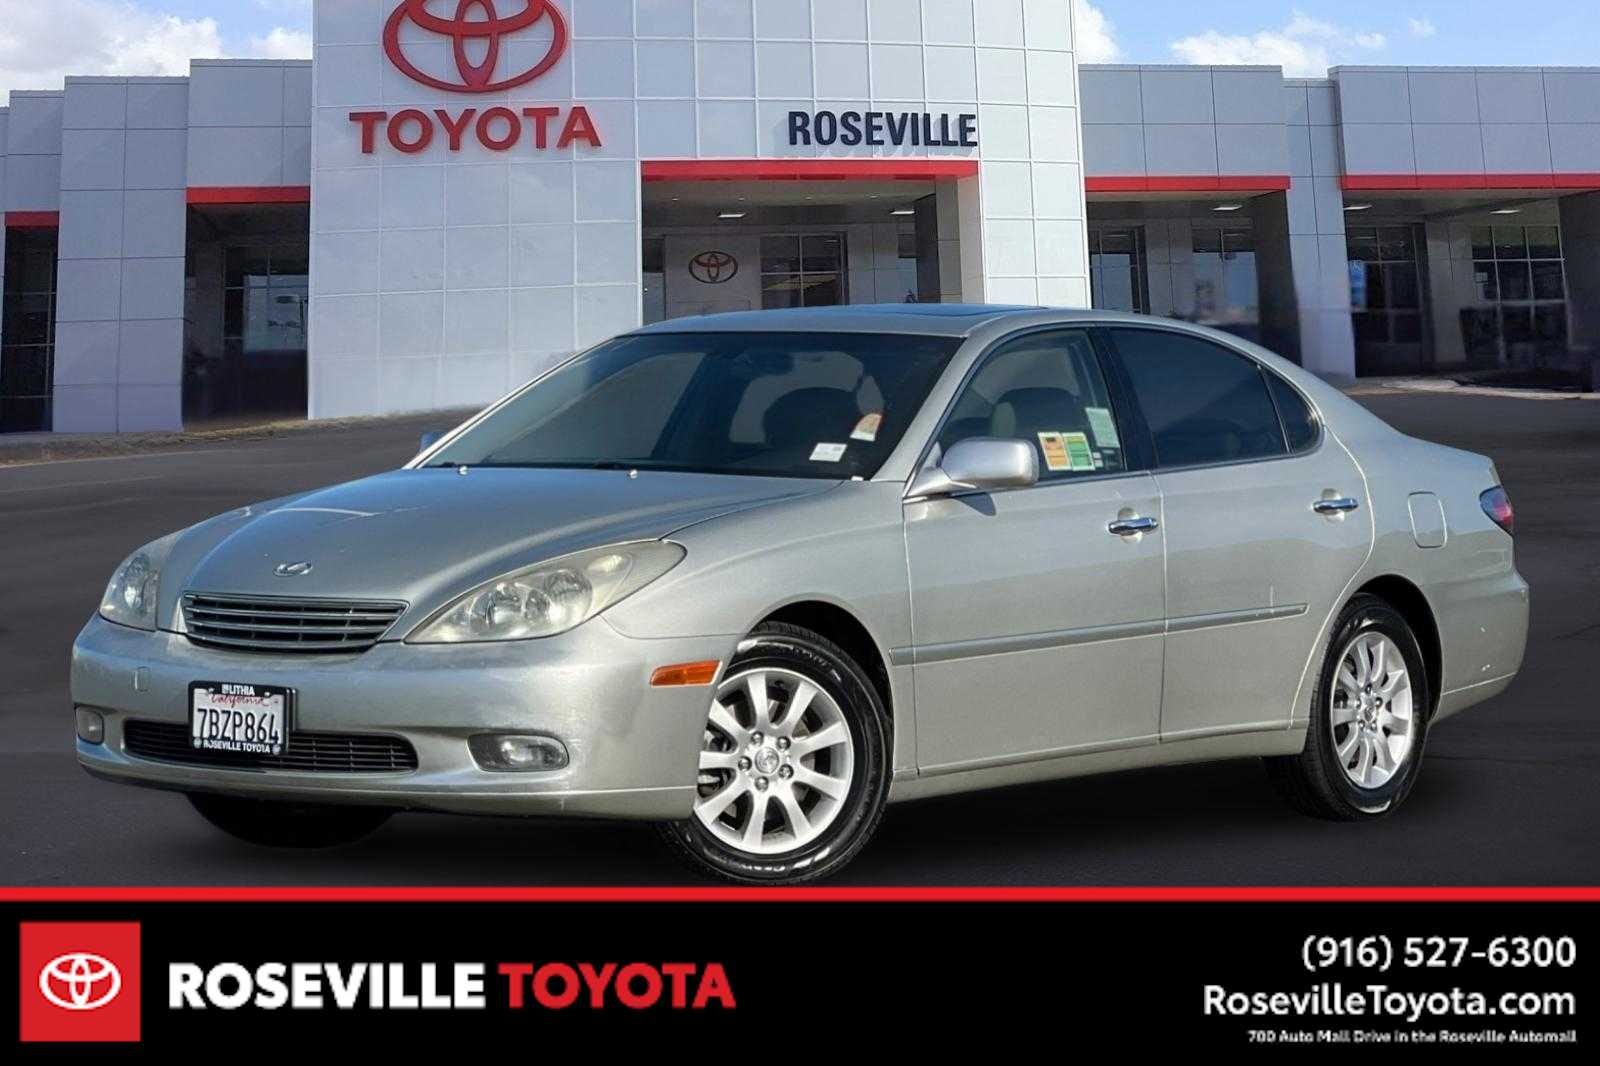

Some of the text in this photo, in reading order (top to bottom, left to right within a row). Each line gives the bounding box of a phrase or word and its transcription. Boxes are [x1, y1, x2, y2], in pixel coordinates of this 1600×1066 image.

[349, 106, 602, 154] TOYOTA
[788, 110, 979, 147] ROSEVILLE
[229, 685, 256, 696] LITHIA
[197, 708, 280, 745] 7BZP864
[203, 740, 271, 754] ROSEVILLE TOYOTA
